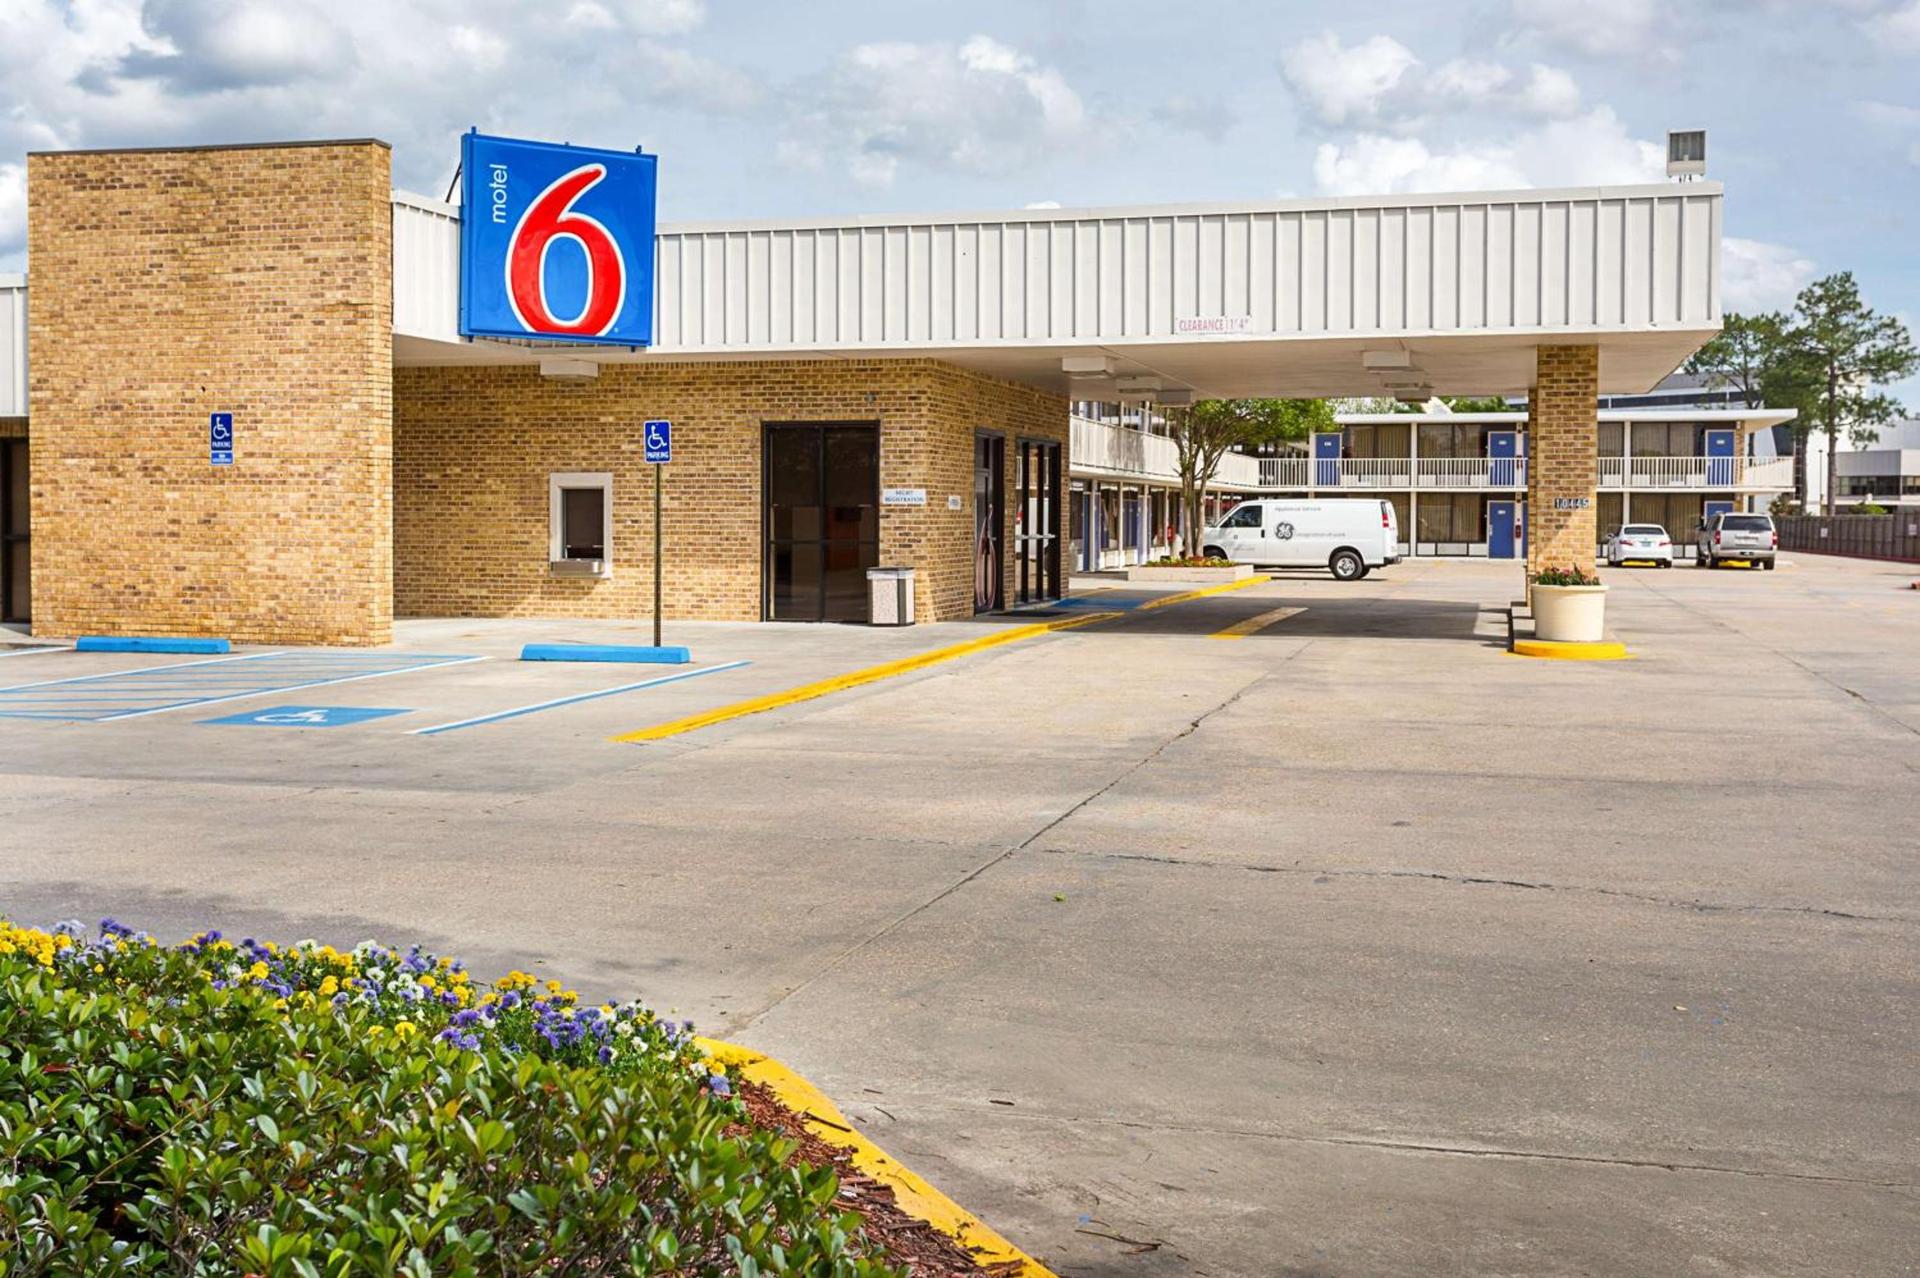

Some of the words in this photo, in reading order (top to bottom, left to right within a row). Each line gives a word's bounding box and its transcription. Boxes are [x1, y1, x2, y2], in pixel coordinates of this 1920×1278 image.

[489, 163, 509, 224] motel
[504, 162, 627, 338] 6
[1179, 318, 1224, 332] CLEARANCE
[1554, 497, 1590, 509] 10445
